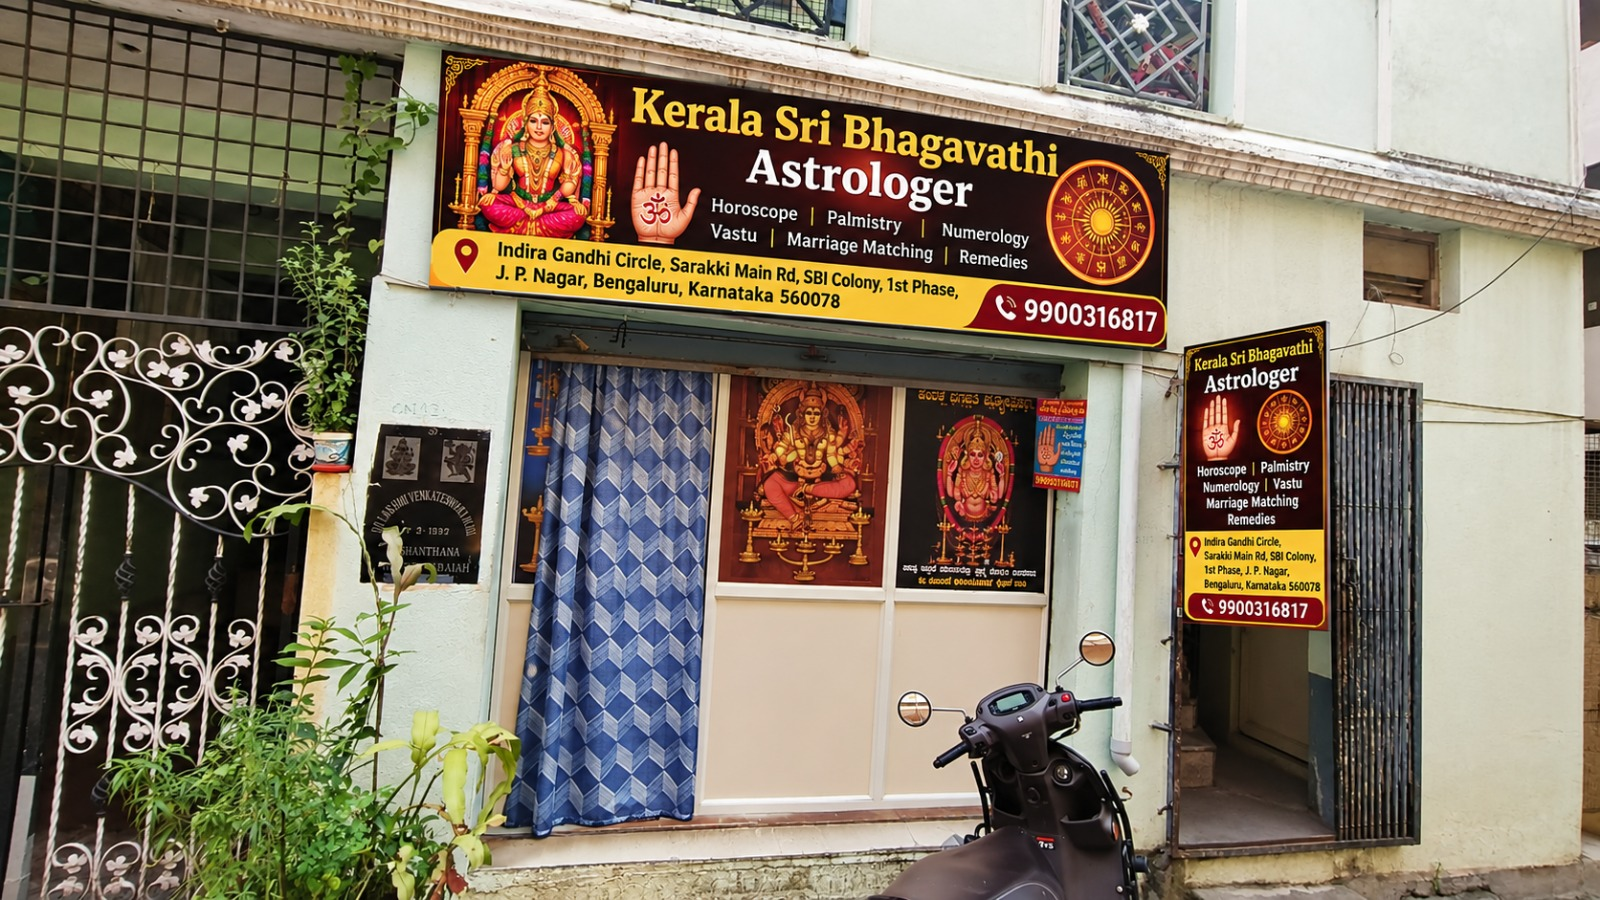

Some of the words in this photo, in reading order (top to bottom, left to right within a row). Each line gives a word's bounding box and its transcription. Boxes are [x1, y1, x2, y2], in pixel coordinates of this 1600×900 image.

[631, 86, 764, 138] Kerala
[774, 106, 831, 146] Sri
[842, 113, 1059, 178] Bhagavathi
[746, 148, 974, 212] Astrologer
[711, 198, 798, 223] Horoscope
[827, 209, 902, 235] Palmistry
[942, 222, 1030, 249] Numerology
[710, 223, 758, 243] Vastu
[787, 231, 859, 255] Marriage
[863, 239, 934, 263] Matching
[959, 249, 1029, 270] Remedies
[497, 241, 547, 261] Indira
[552, 246, 611, 267] Gandhi
[615, 251, 666, 274] Circle,
[670, 256, 730, 277] Sarakki
[735, 263, 772, 281] Main
[777, 266, 800, 286] Rd,
[803, 269, 828, 286] SBI
[831, 272, 884, 294] Colony,
[886, 277, 909, 293] 1st
[912, 279, 960, 300] Phase,
[495, 264, 509, 281] J.
[514, 266, 527, 282] P.
[533, 268, 588, 289] Nagar,
[593, 273, 684, 298] Bengaluru,
[688, 280, 774, 303] Karnataka
[780, 289, 841, 309] 560078
[1024, 298, 1158, 334] 9900316817
[1194, 353, 1229, 372] Kerala
[1230, 350, 1247, 367] Sri
[1248, 338, 1314, 365] Bhagavathi
[1204, 364, 1299, 394] Astrologer
[1197, 462, 1247, 480] Horoscope
[1260, 459, 1310, 475] Palmistry
[1203, 480, 1260, 495] Numerology
[1273, 478, 1303, 491] Vastu
[1206, 497, 1249, 512] Marriage
[1251, 494, 1299, 510] Matching
[1228, 512, 1276, 526] Remedies
[1204, 536, 1226, 548] Indira
[1227, 536, 1255, 548] Gandhi
[1256, 537, 1282, 549] Circle,
[1204, 550, 1232, 561] Sarakki
[1233, 551, 1252, 562] Main
[1254, 551, 1268, 563] Rd,
[1270, 551, 1284, 562] SBI
[1285, 551, 1317, 564] Colony,
[1204, 565, 1216, 575] 1st
[1217, 565, 1243, 577] Phase,
[1245, 565, 1252, 576] J.
[1253, 565, 1261, 576] P.
[1263, 566, 1290, 579] Nagar,
[1204, 578, 1244, 592] Bengaluru,
[1245, 580, 1287, 592] Karnataka
[1288, 580, 1321, 593] 560078
[1218, 599, 1309, 619] 9900316817
